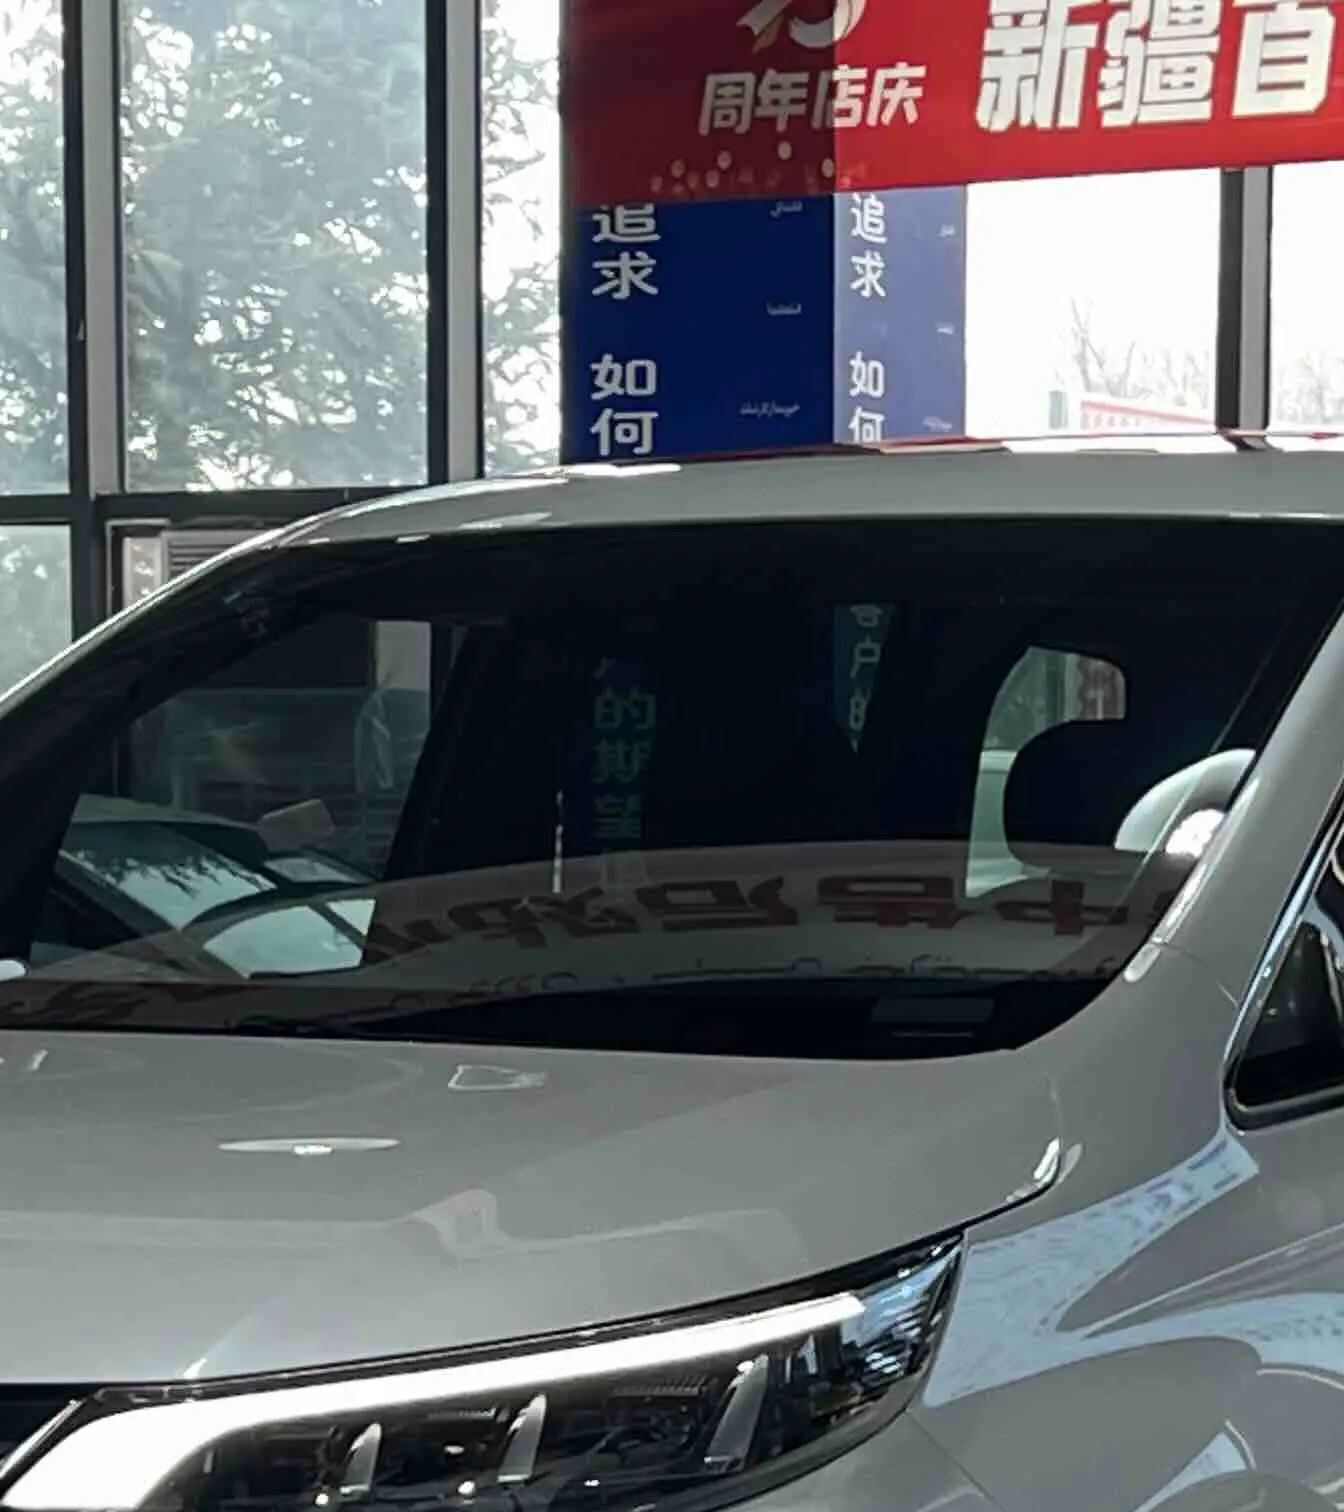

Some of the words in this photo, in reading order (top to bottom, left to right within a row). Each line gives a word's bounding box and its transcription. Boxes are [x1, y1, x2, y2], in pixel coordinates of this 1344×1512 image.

[698, 61, 927, 137] 周年店庆
[590, 203, 661, 301] 追求
[850, 191, 888, 299] 追求
[589, 353, 660, 457] 如何
[847, 351, 887, 442] 如何
[591, 656, 658, 841] 的期望
